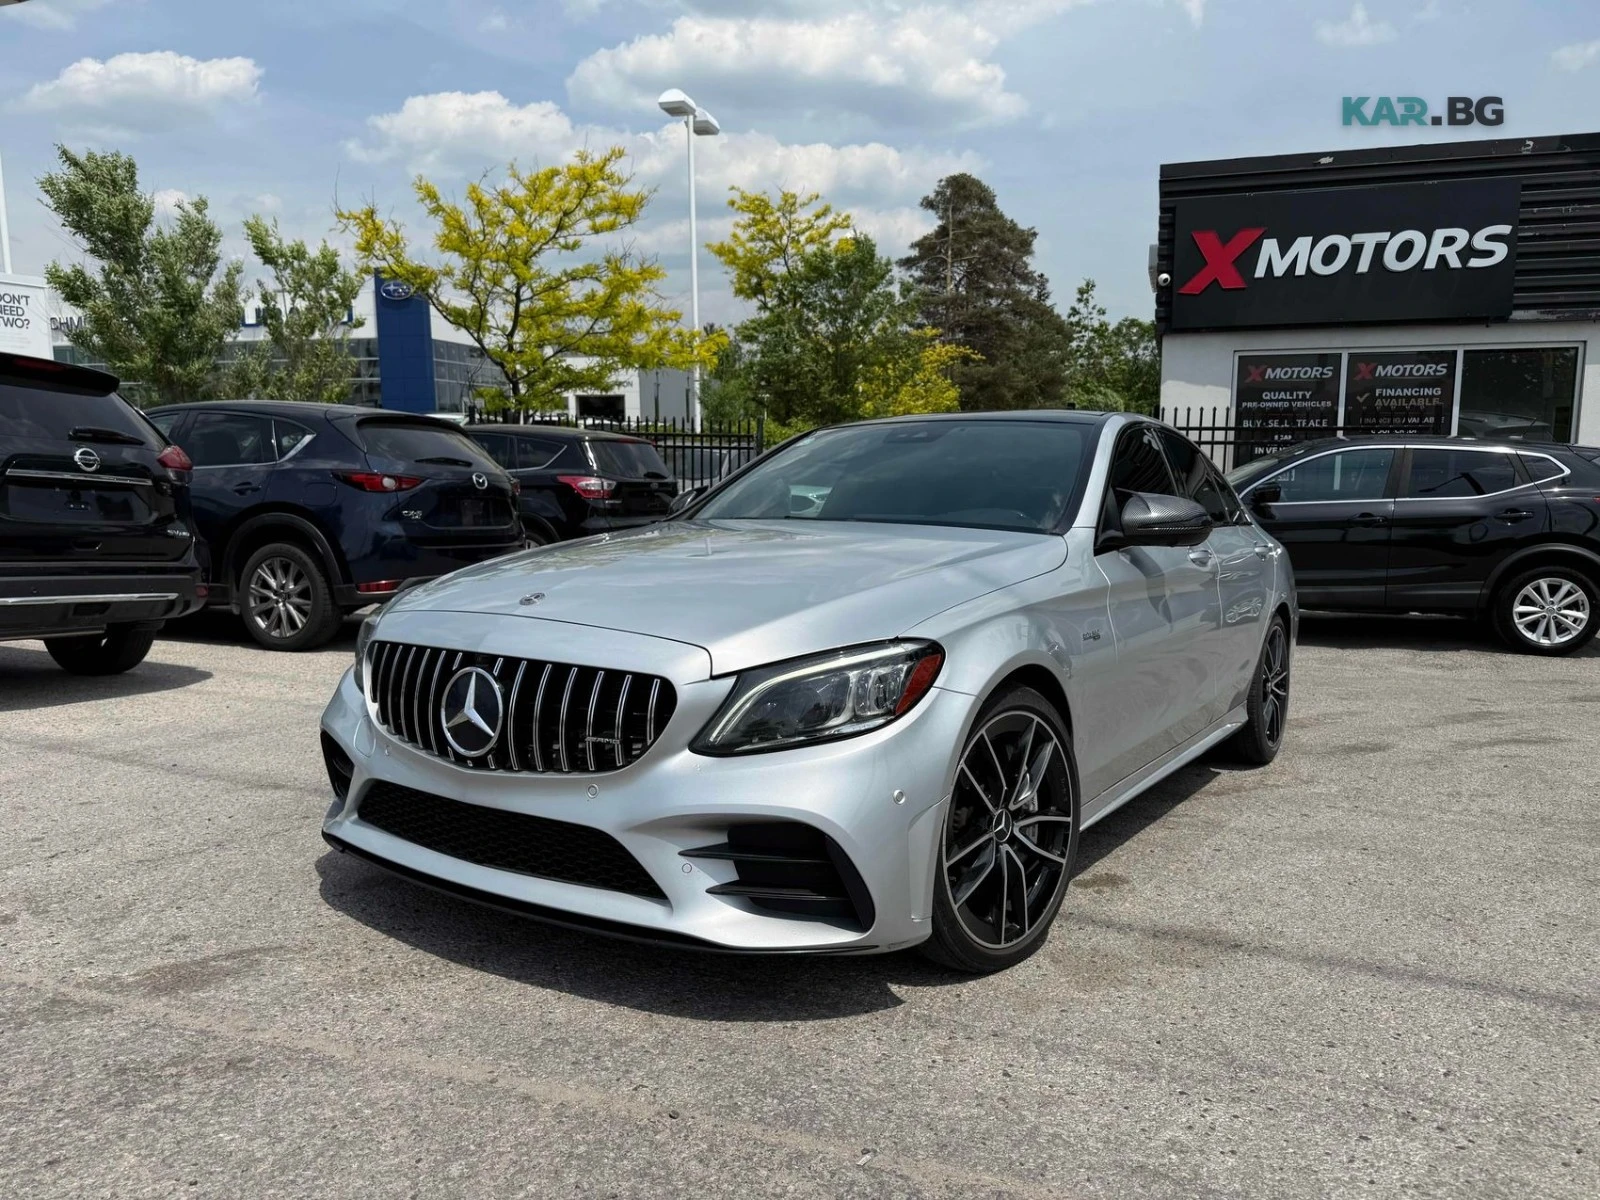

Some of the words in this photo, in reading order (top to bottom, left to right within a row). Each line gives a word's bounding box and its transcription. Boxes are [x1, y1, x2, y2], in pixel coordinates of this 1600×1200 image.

[0, 292, 30, 306] ON'T
[1262, 390, 1313, 400] QUALITY
[1375, 387, 1442, 397] FINANCING
[1291, 400, 1332, 408] VEHICLES
[1374, 397, 1440, 407] AVAILABLE
